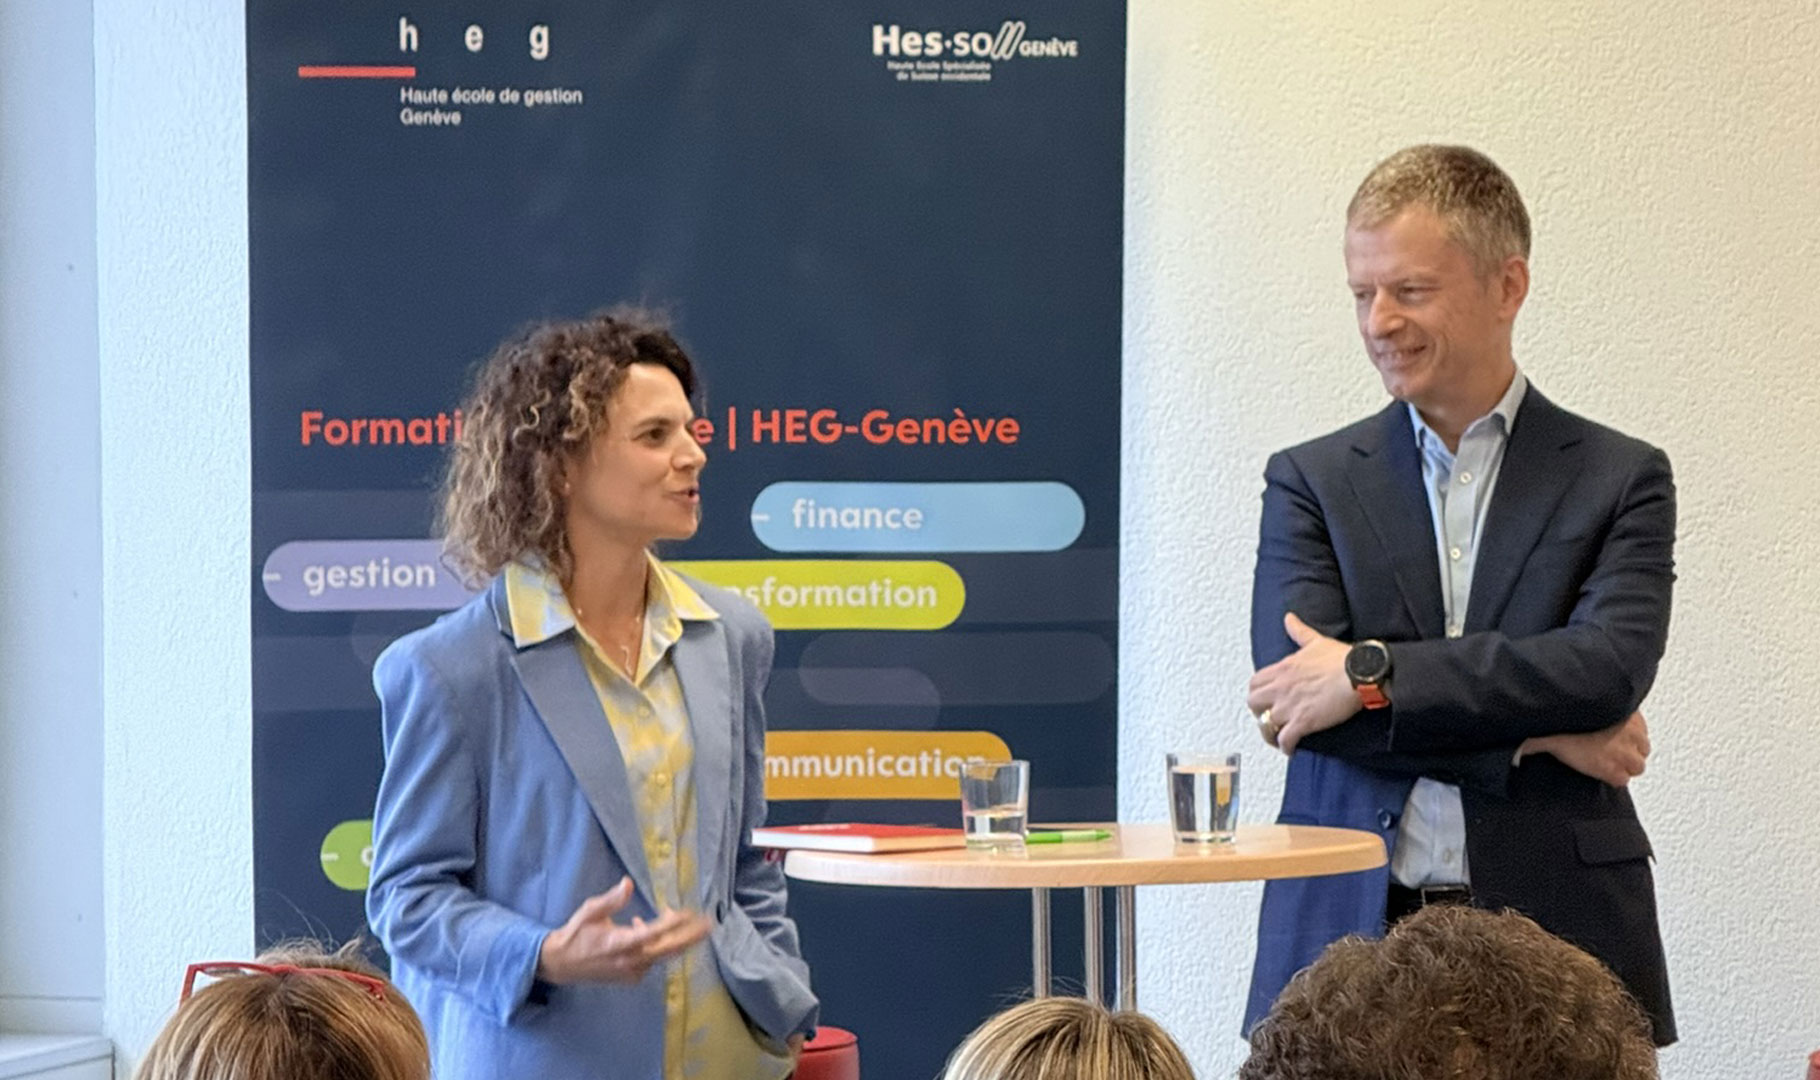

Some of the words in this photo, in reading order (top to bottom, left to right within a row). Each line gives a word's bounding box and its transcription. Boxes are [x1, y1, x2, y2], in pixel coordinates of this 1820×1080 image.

[1018, 37, 1079, 57] GENÈVE
[400, 87, 448, 104] Haute
[451, 87, 496, 104] école
[499, 87, 521, 104] de
[523, 87, 583, 108] gestion
[400, 107, 462, 126] Genève
[301, 408, 464, 446] Formati
[752, 408, 1020, 445] HEG-Genève
[792, 498, 923, 529] finance
[303, 557, 436, 597] gestion
[720, 575, 937, 608] sformation
[764, 748, 986, 778] mmunicatio
